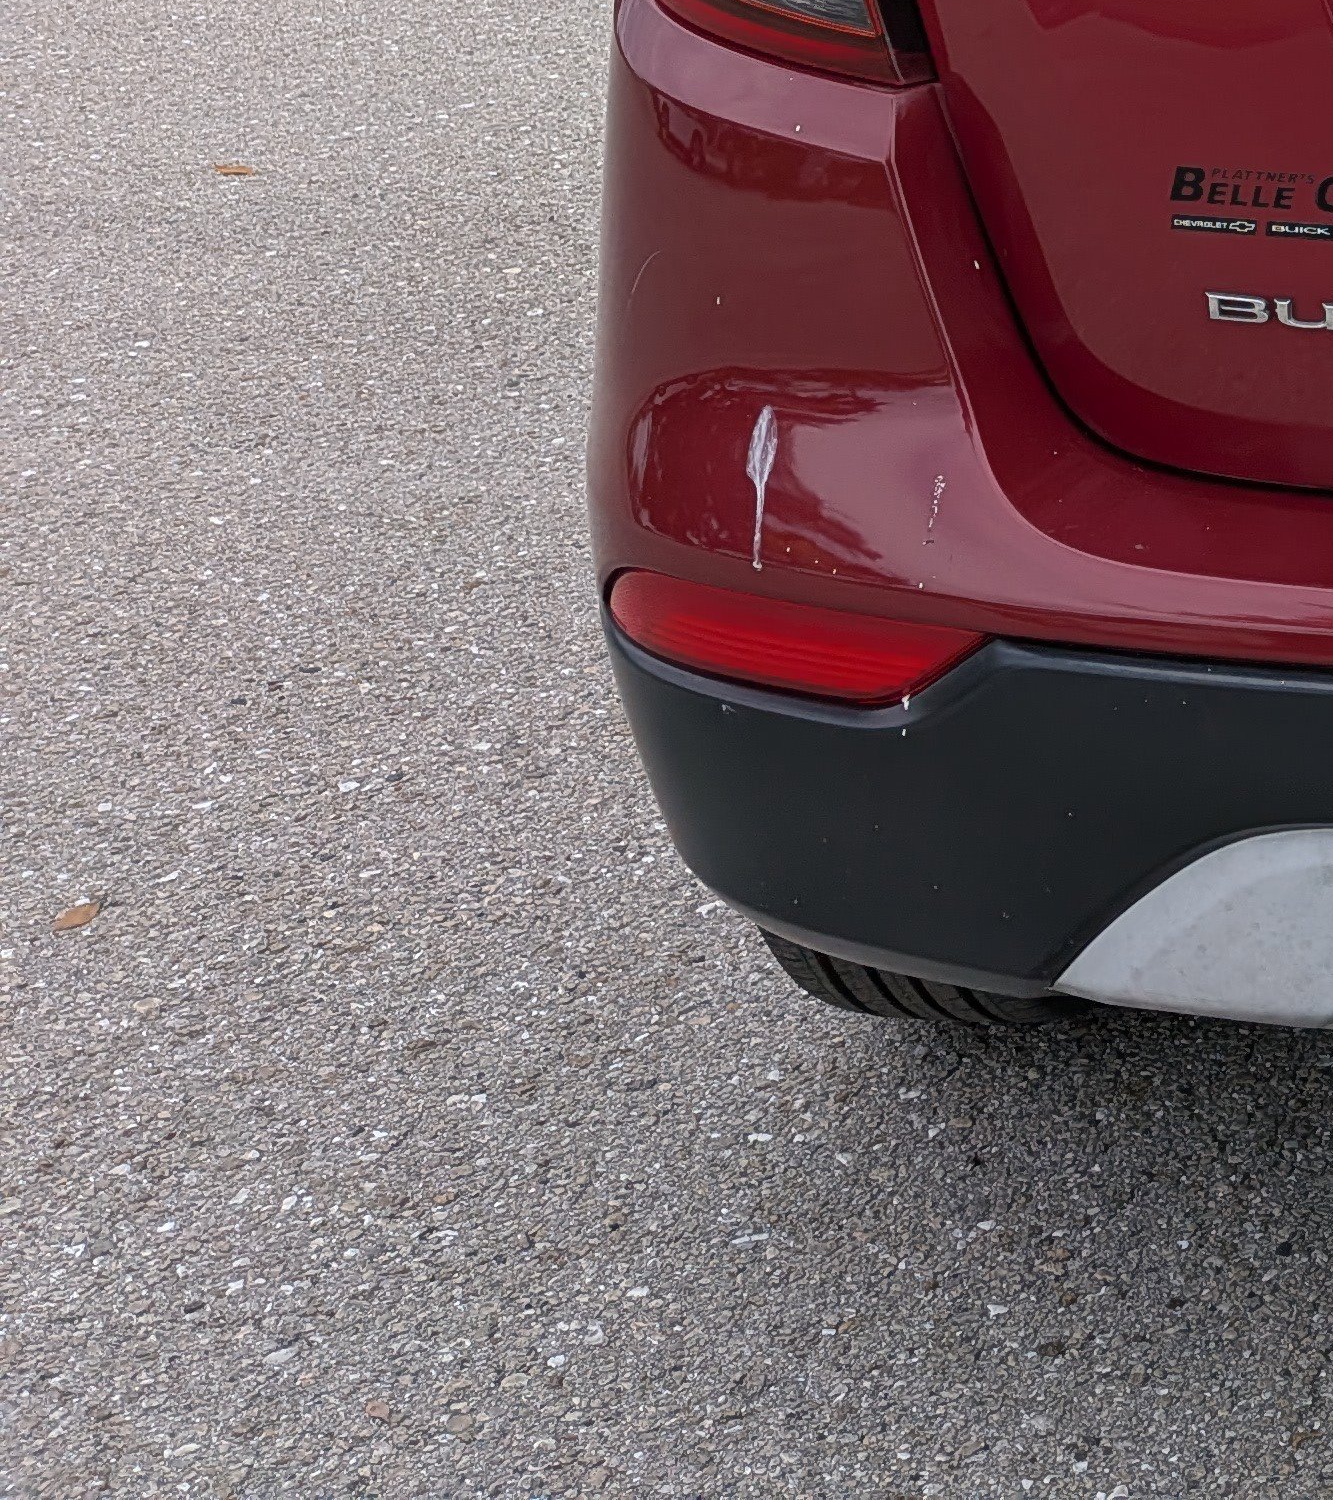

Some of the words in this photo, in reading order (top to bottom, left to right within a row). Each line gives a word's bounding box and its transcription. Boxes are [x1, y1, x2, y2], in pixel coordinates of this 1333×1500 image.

[1211, 167, 1316, 185] PLATTNER'S
[1173, 218, 1228, 230] CHEVROLET
[1271, 224, 1331, 237] BUICK
